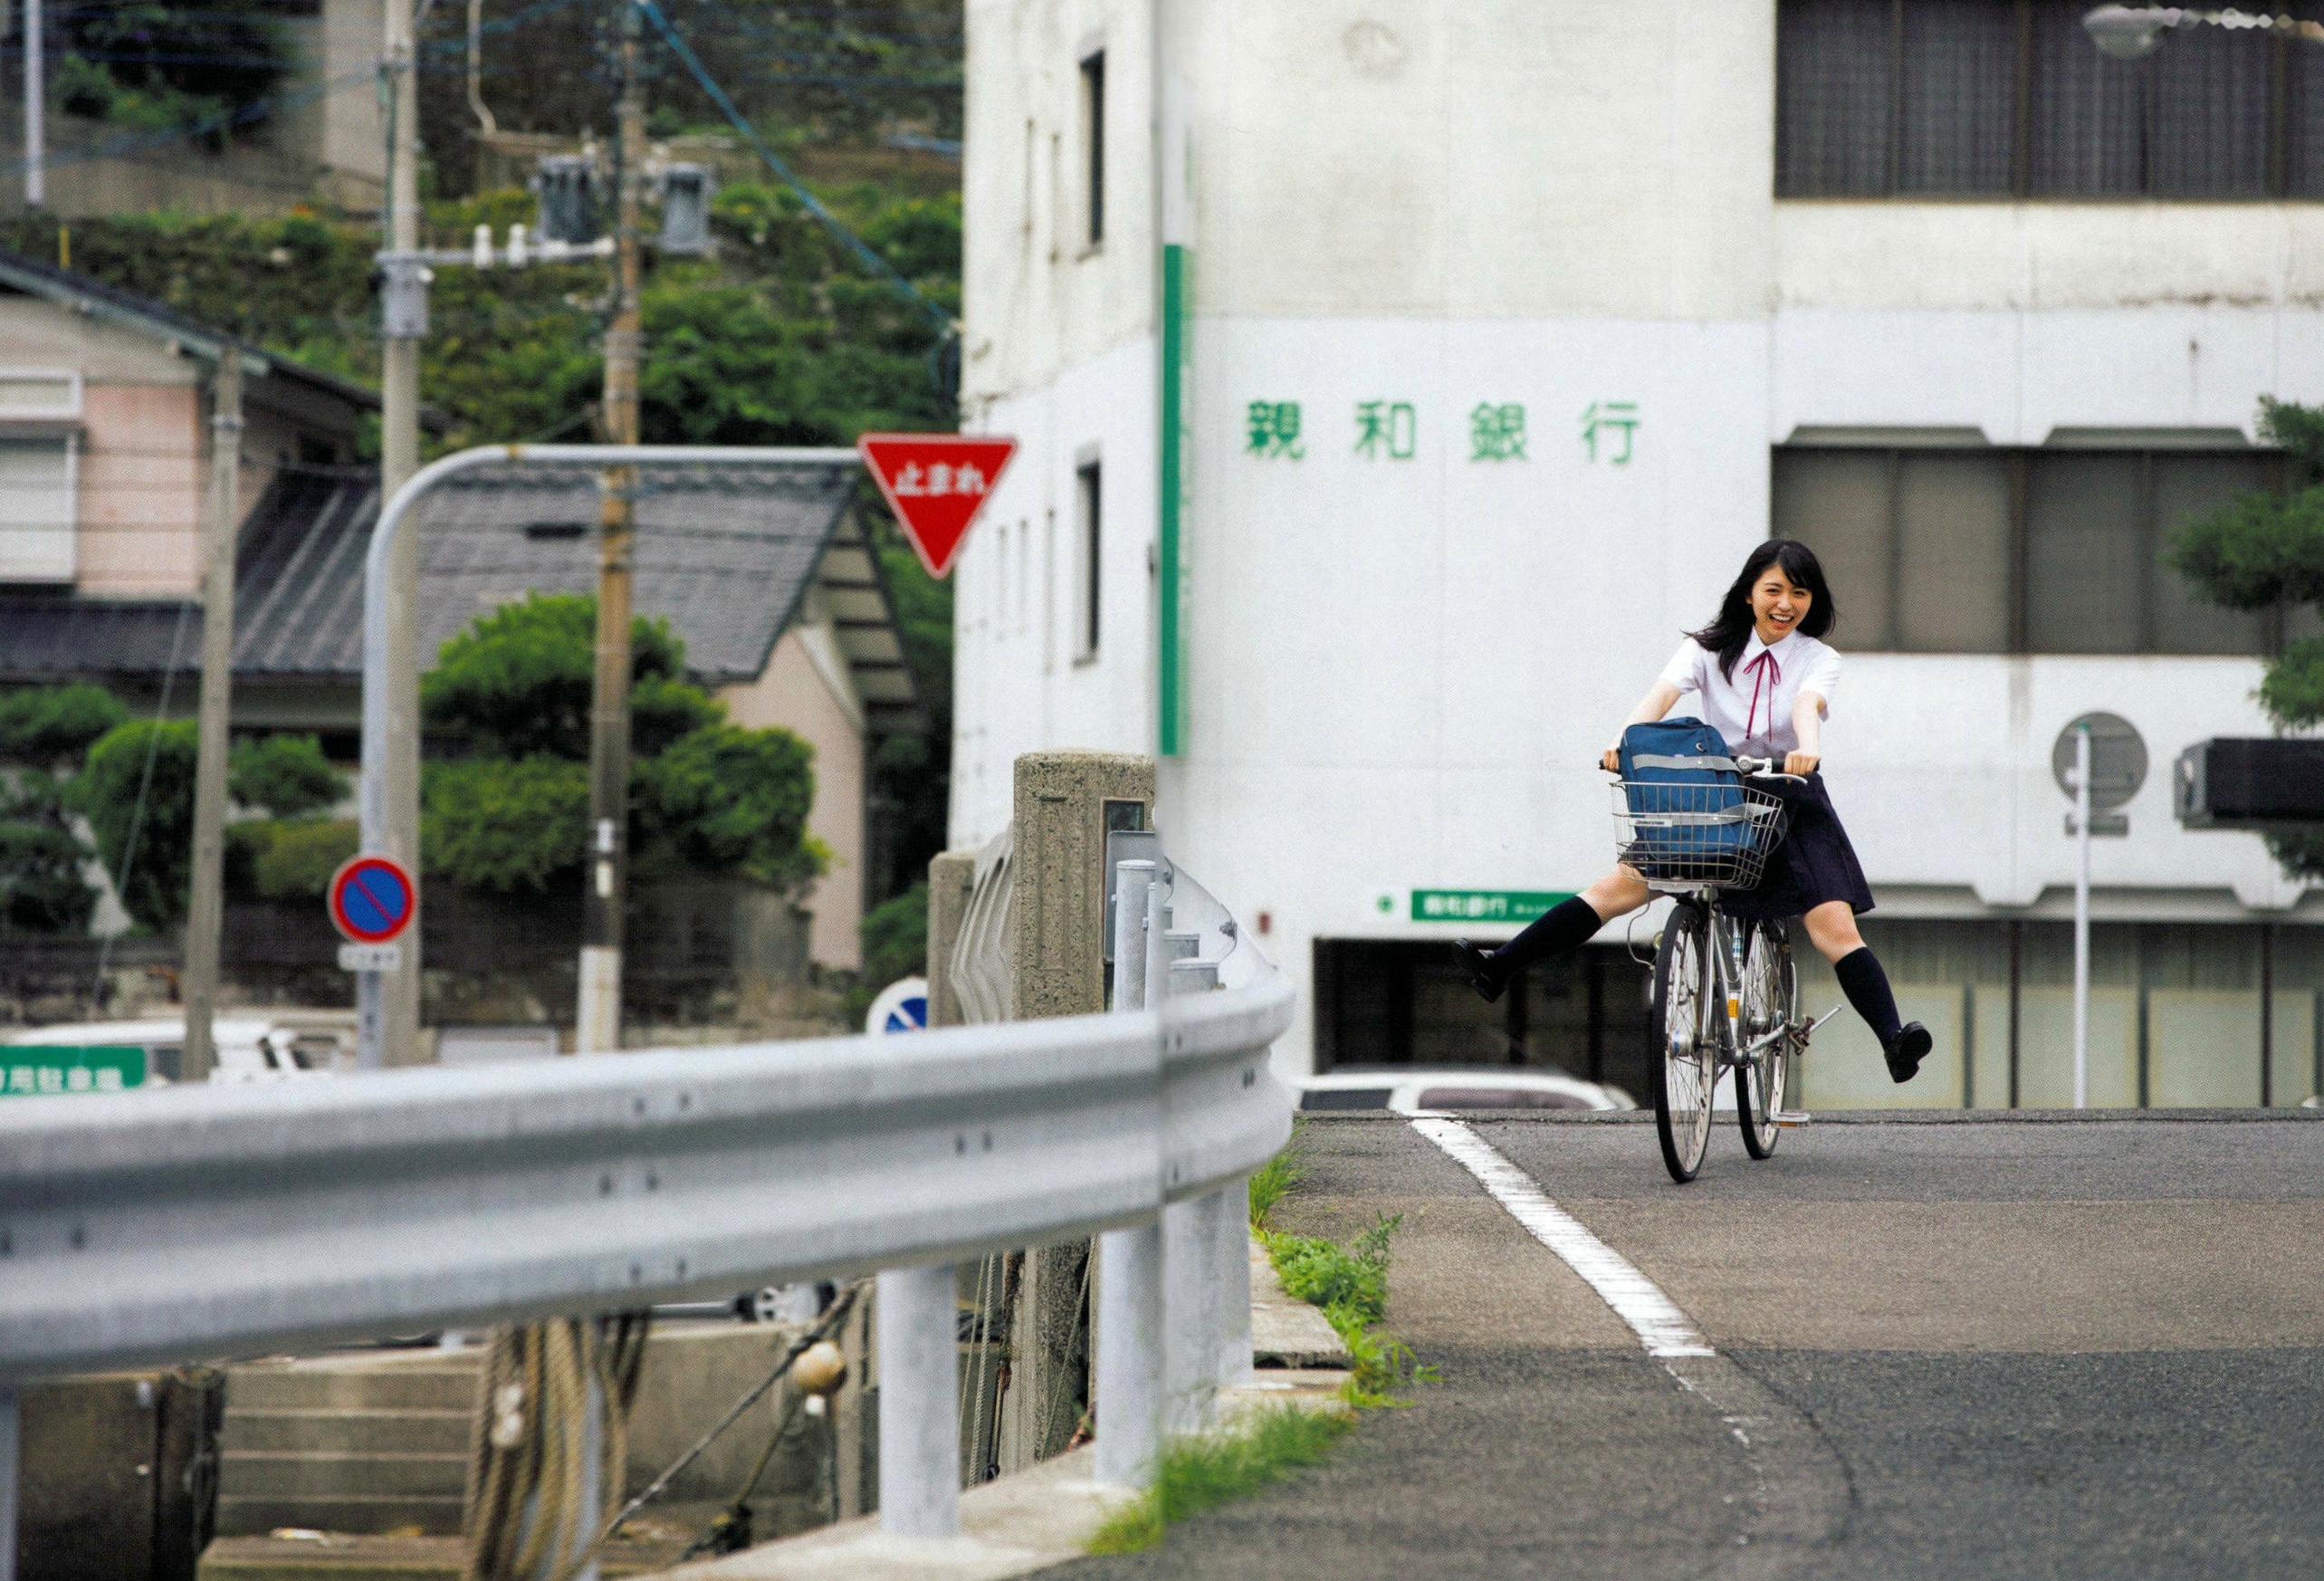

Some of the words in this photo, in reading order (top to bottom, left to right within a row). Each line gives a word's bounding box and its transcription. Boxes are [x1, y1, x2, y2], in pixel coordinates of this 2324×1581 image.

[1248, 400, 1640, 465] 親和銀行
[894, 462, 985, 496] 止まれ
[0, 1067, 122, 1093] 用駐車場
